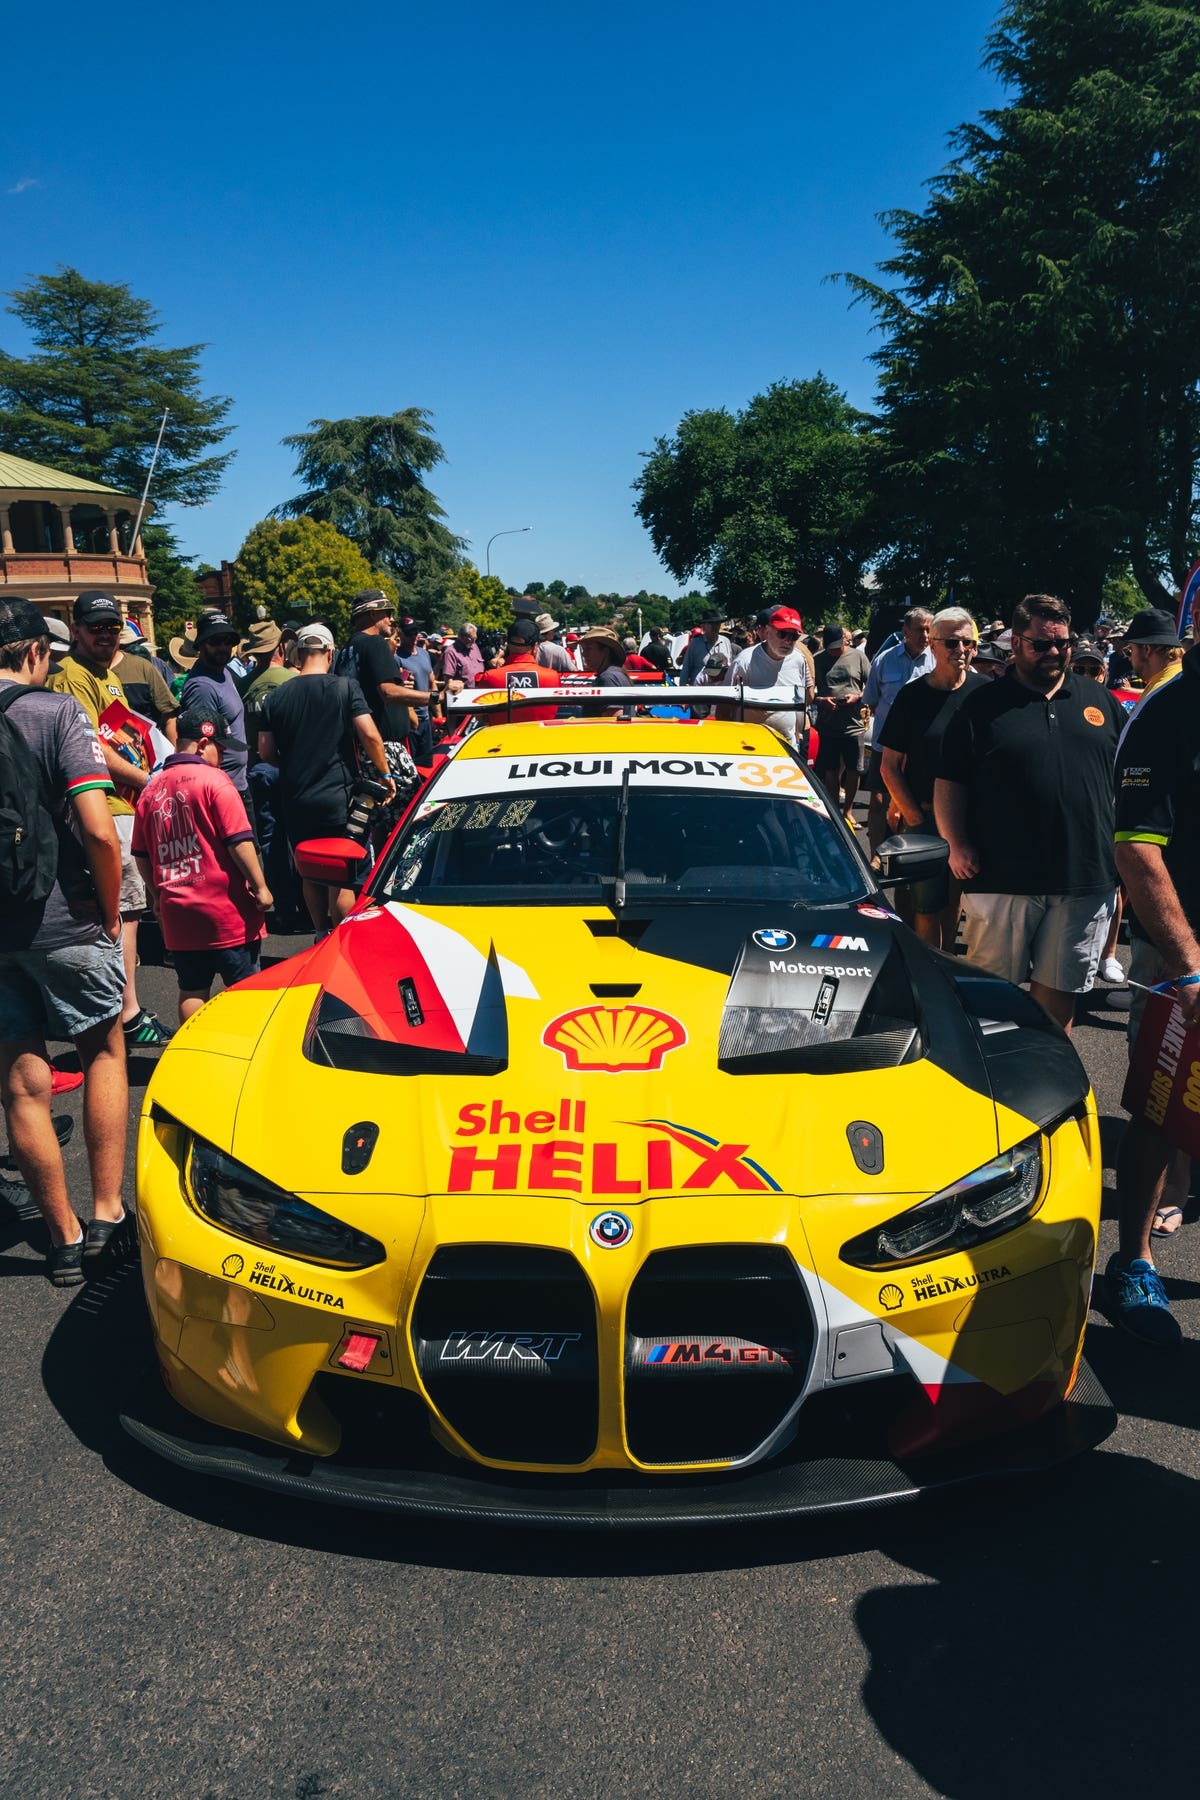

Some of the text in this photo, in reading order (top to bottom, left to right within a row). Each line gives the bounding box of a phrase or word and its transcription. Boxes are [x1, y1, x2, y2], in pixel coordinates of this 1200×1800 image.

[508, 759, 734, 779] LIQUI MOLY
[736, 762, 809, 791] 32
[157, 833, 201, 864] PINK
[159, 854, 203, 882] TEST
[769, 960, 872, 978] Motorsport
[1144, 1003, 1187, 1127] MAKE IT SUPER
[455, 1098, 586, 1137] Shell
[447, 1122, 772, 1194] HELIX
[254, 1262, 276, 1274] Shell
[911, 1274, 933, 1288] Shell
[249, 1271, 345, 1309] HELIX ULTRA
[913, 1265, 1011, 1301] HELIX ULTRA
[440, 1331, 582, 1360] WRT
[666, 1343, 734, 1363] M4
